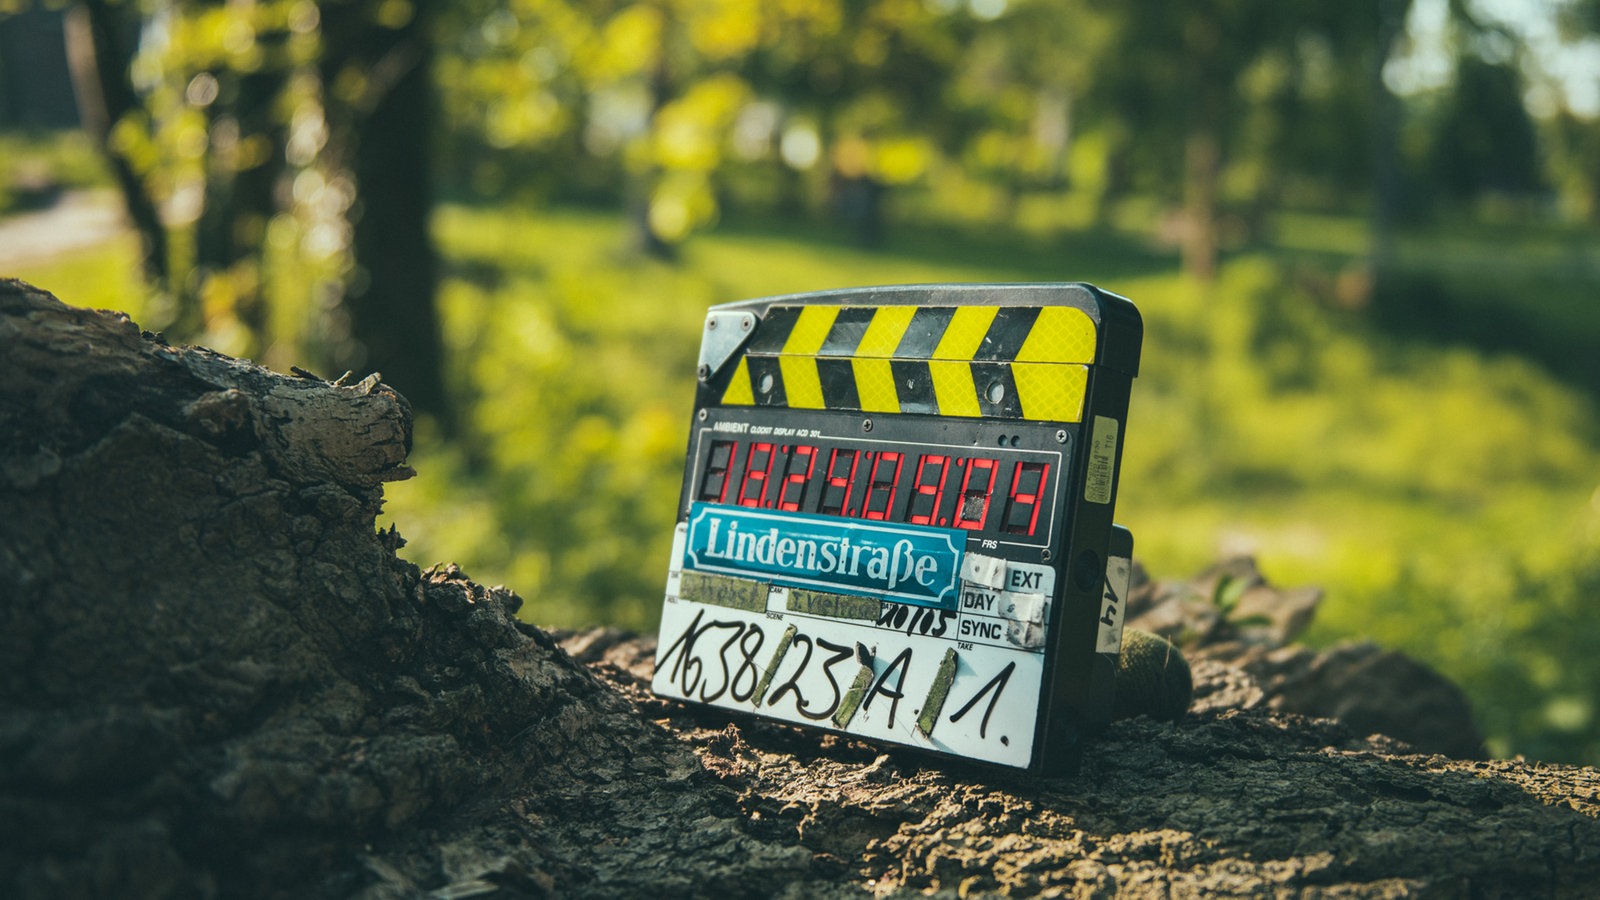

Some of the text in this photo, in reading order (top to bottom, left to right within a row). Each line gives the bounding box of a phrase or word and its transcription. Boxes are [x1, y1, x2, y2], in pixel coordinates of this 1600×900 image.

[713, 421, 749, 433] AMBIENT
[773, 427, 795, 436] DISPLAY
[796, 429, 809, 437] ACD
[982, 539, 998, 550] FRS
[705, 517, 938, 590] Lindenstraße
[1011, 570, 1043, 589] EXT
[964, 591, 995, 611] DAY
[766, 612, 783, 621] SCENE
[961, 619, 1002, 640] SYNC
[957, 642, 974, 652] TAKE
